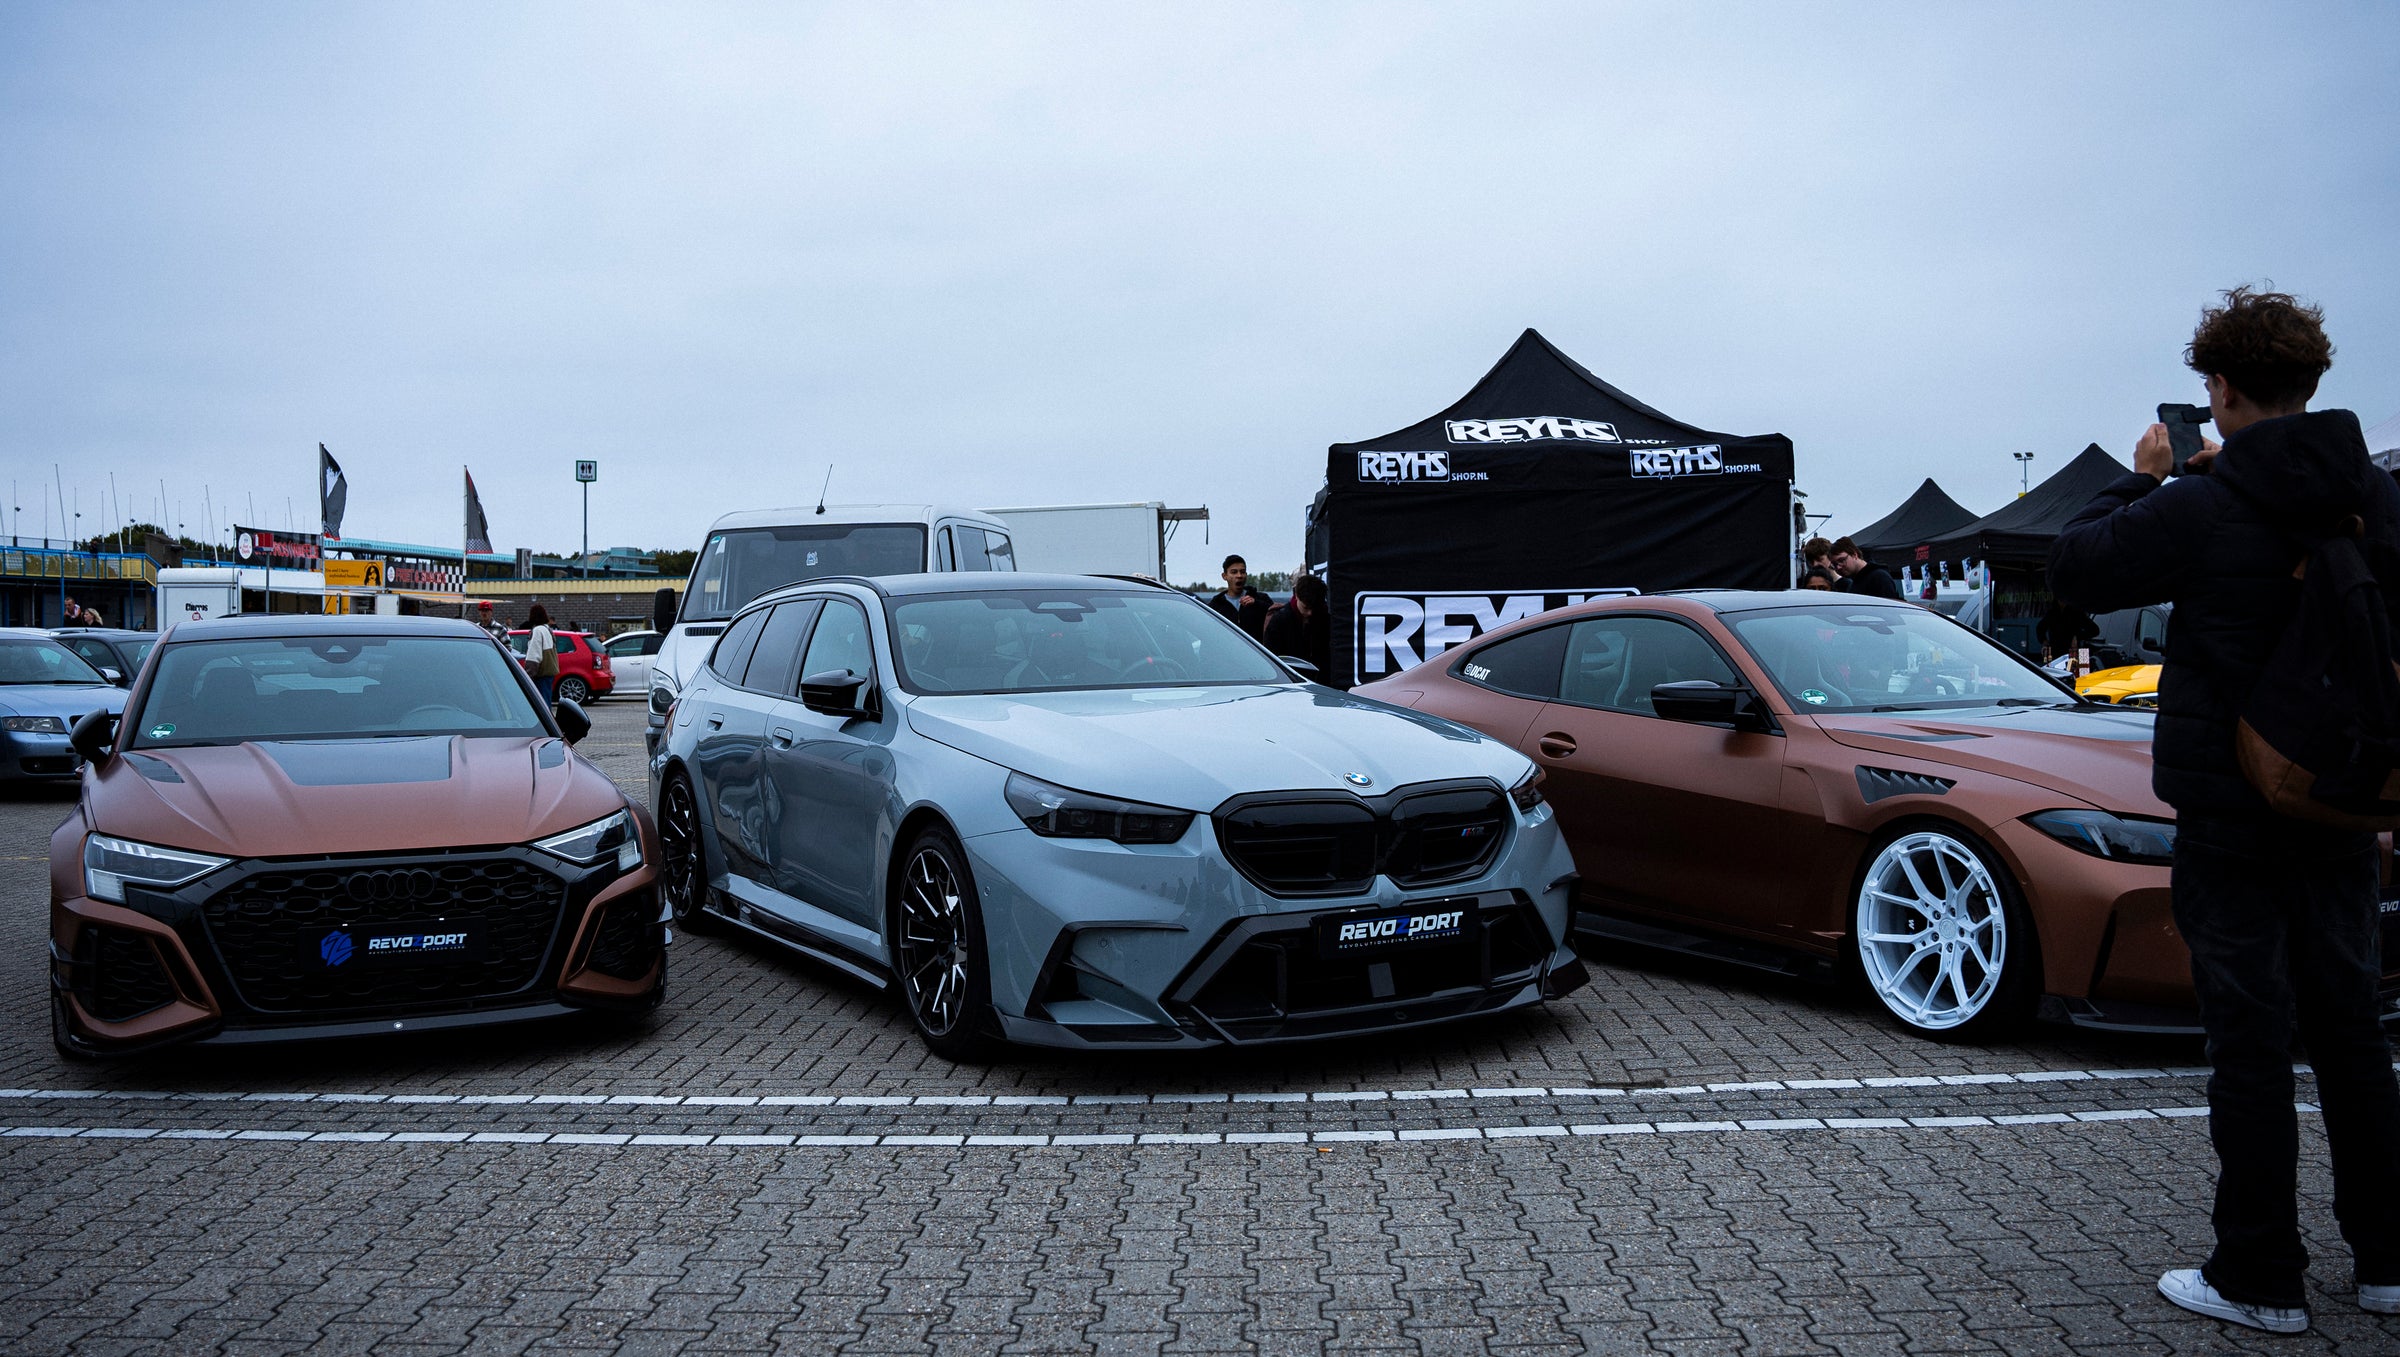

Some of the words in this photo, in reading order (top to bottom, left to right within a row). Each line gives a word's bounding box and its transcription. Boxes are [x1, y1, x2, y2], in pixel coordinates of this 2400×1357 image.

[1449, 418, 1617, 442] REYHS
[1360, 451, 1448, 480] REYHS
[1452, 472, 1489, 481] SHOP.NL
[1632, 445, 1721, 475] REYHS
[1725, 464, 1762, 473] SHOP.NL
[1464, 663, 1491, 681] @DCAT
[1339, 911, 1463, 941] REVOZPORT
[369, 933, 467, 950] REVOZPORT
